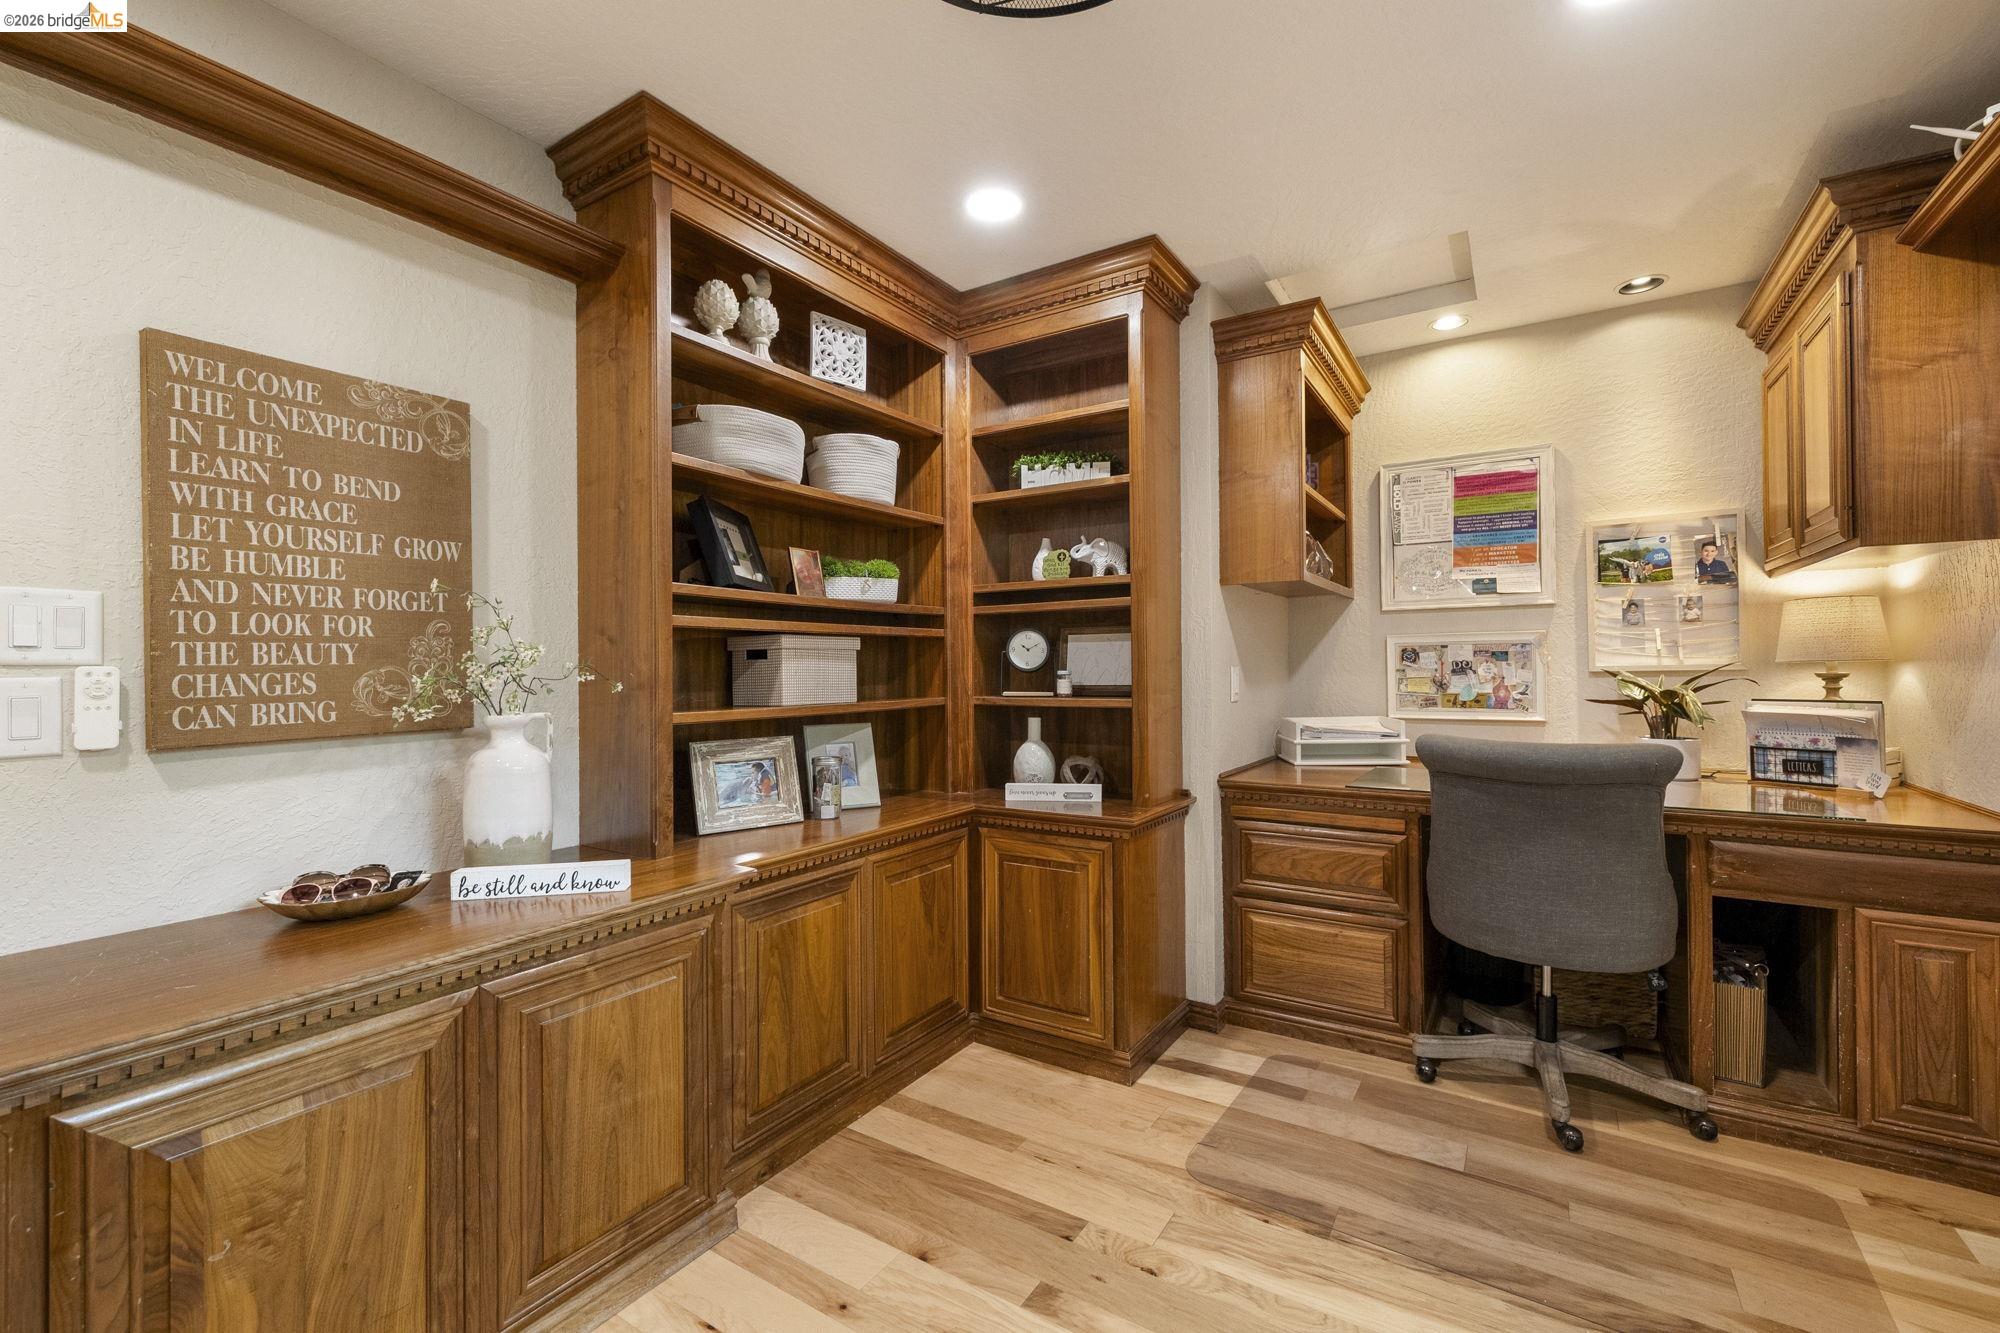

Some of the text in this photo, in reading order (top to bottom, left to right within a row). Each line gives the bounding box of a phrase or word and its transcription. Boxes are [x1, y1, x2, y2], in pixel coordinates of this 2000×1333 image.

[164, 350, 322, 405] WELCOME
[167, 381, 423, 453] THE UNEXPECTED
[168, 416, 284, 459] IN LIFE
[168, 449, 401, 502] LEARN TO BEND
[168, 480, 358, 525] WITH GRACE
[1393, 485, 1401, 510] BOLD
[170, 512, 463, 563] LET YOURSELF GROW
[170, 545, 347, 581] BE HUMBLE
[170, 578, 448, 613] AND NEVER FORGET
[170, 609, 375, 637] TO LOOK FOR
[171, 641, 359, 667] THE BEAUTY
[171, 672, 317, 699] CHANGES
[172, 701, 337, 731] CAN BRING
[458, 871, 621, 898] be still and know
